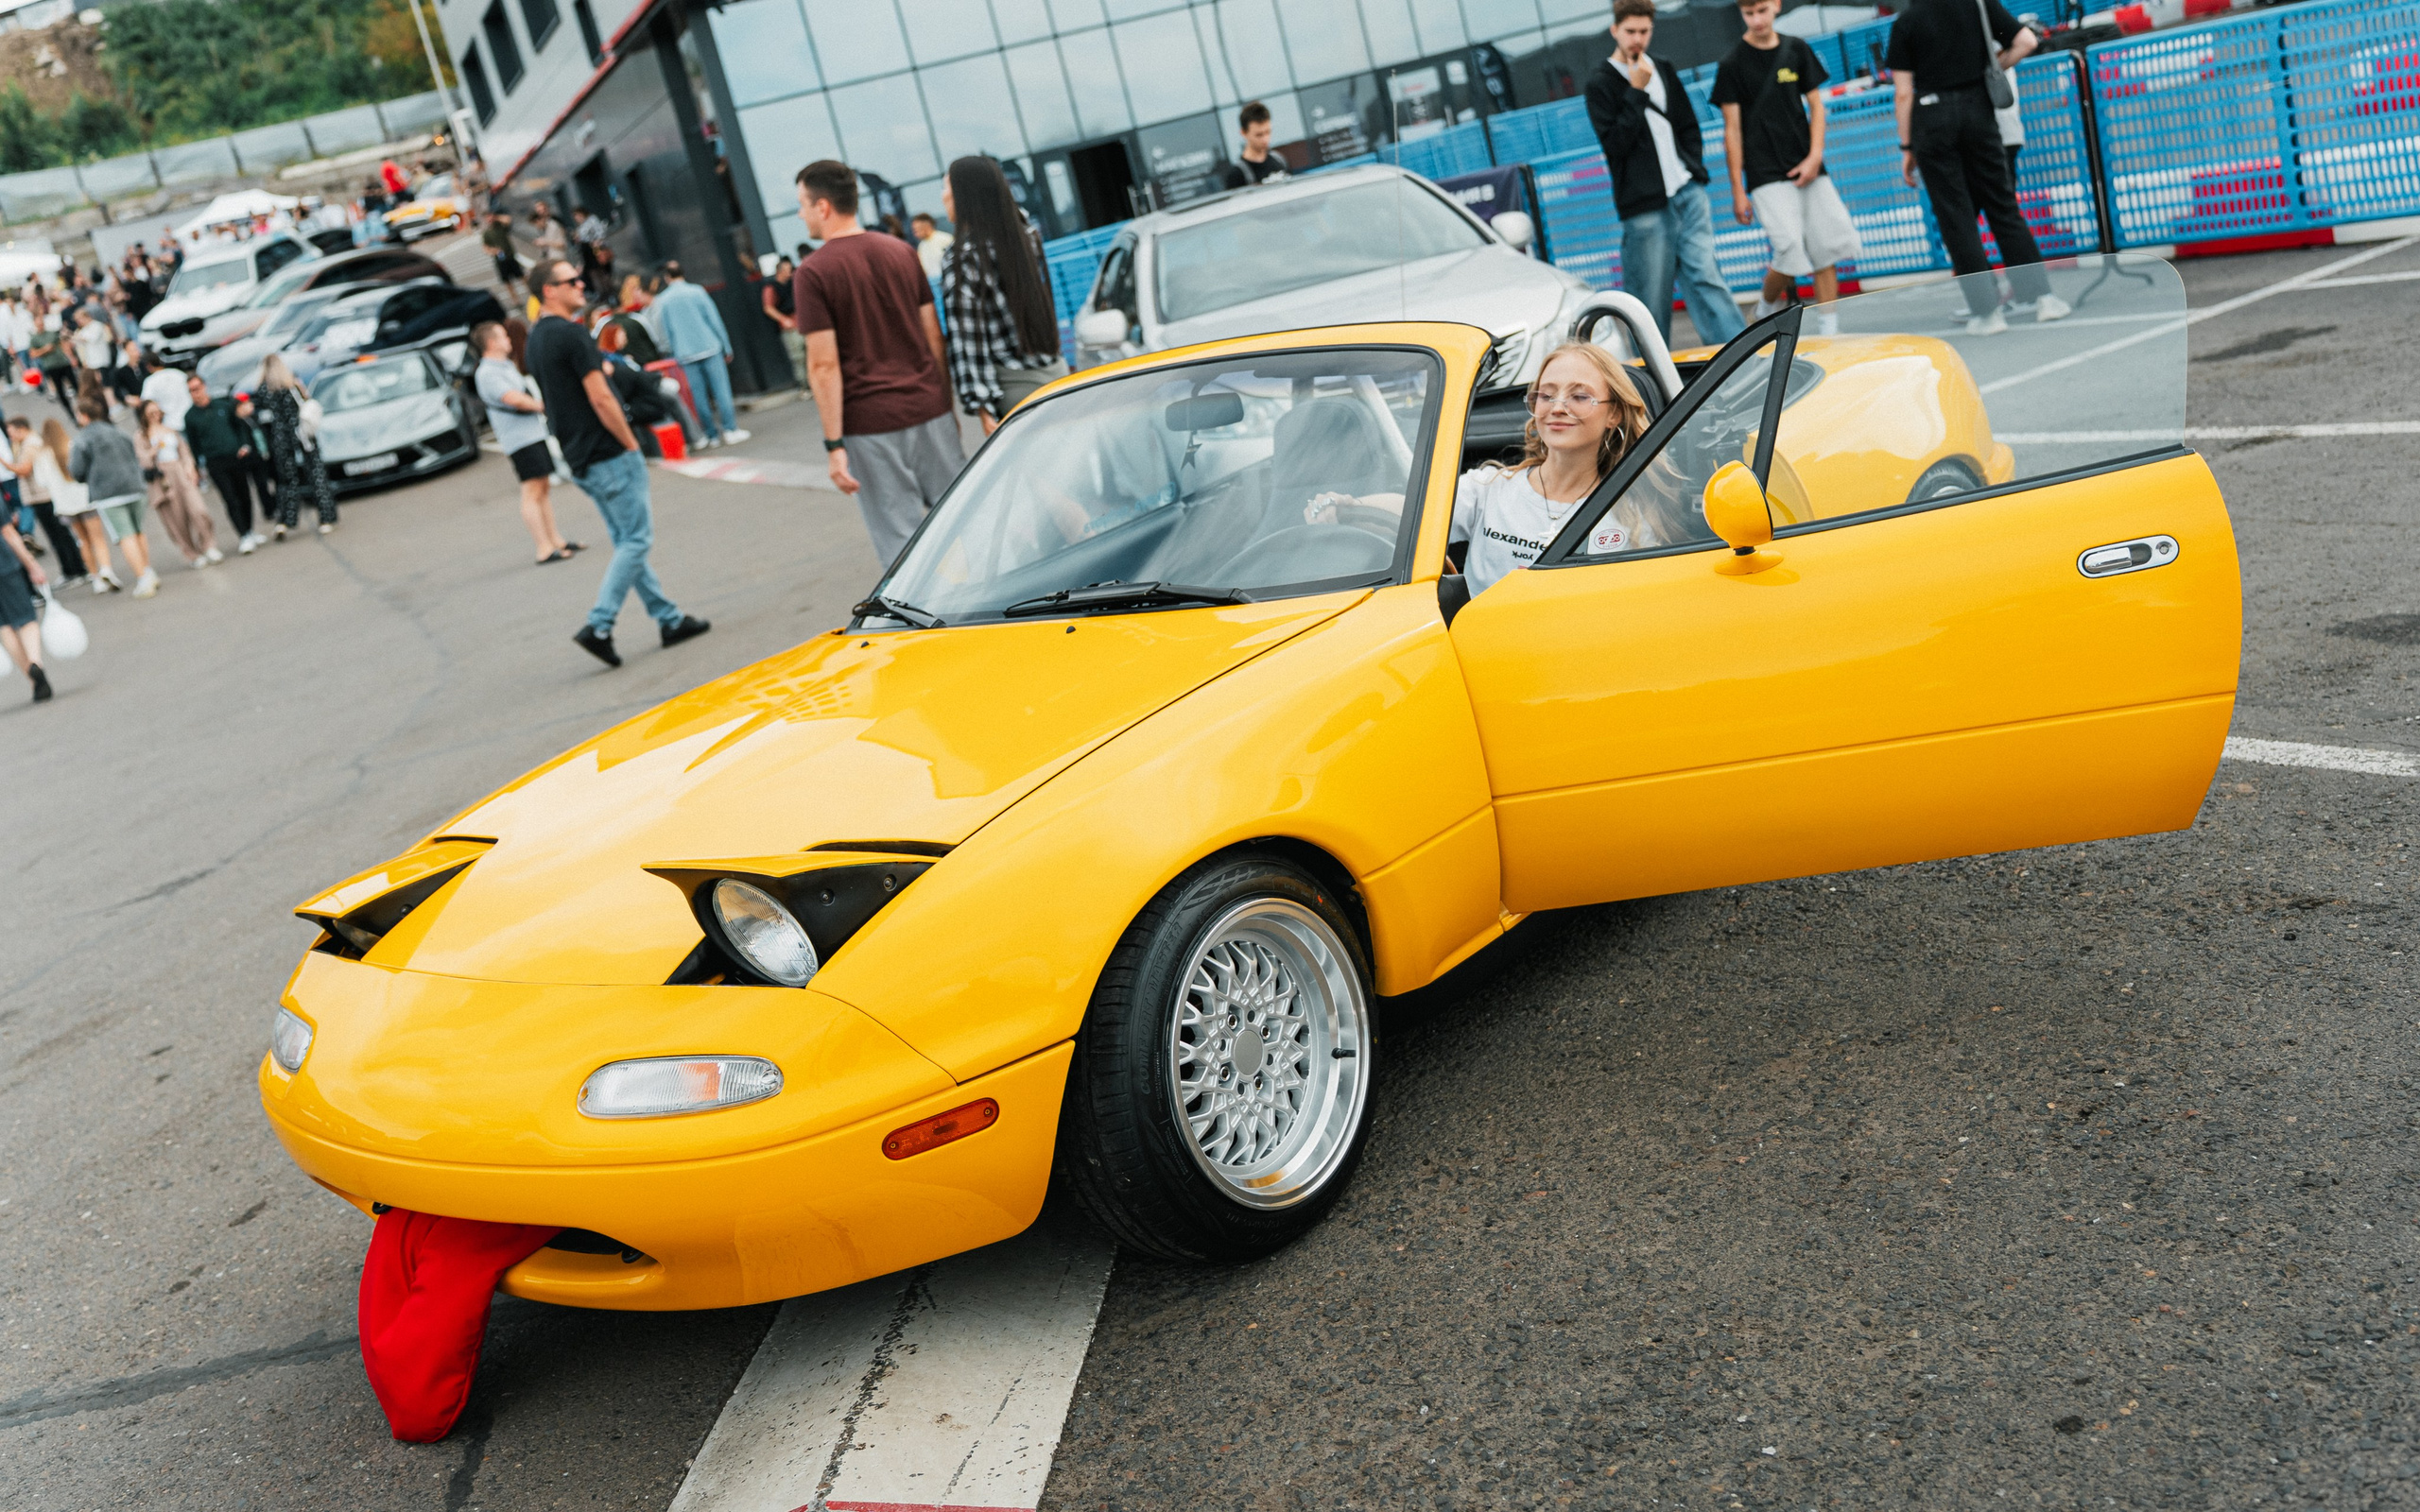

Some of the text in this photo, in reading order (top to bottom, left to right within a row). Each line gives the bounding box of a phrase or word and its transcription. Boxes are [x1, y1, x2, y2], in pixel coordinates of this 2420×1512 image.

[1512, 550, 1533, 560] york
[1138, 997, 1155, 1094] COMFORT
[1148, 921, 1184, 992] MASTER
